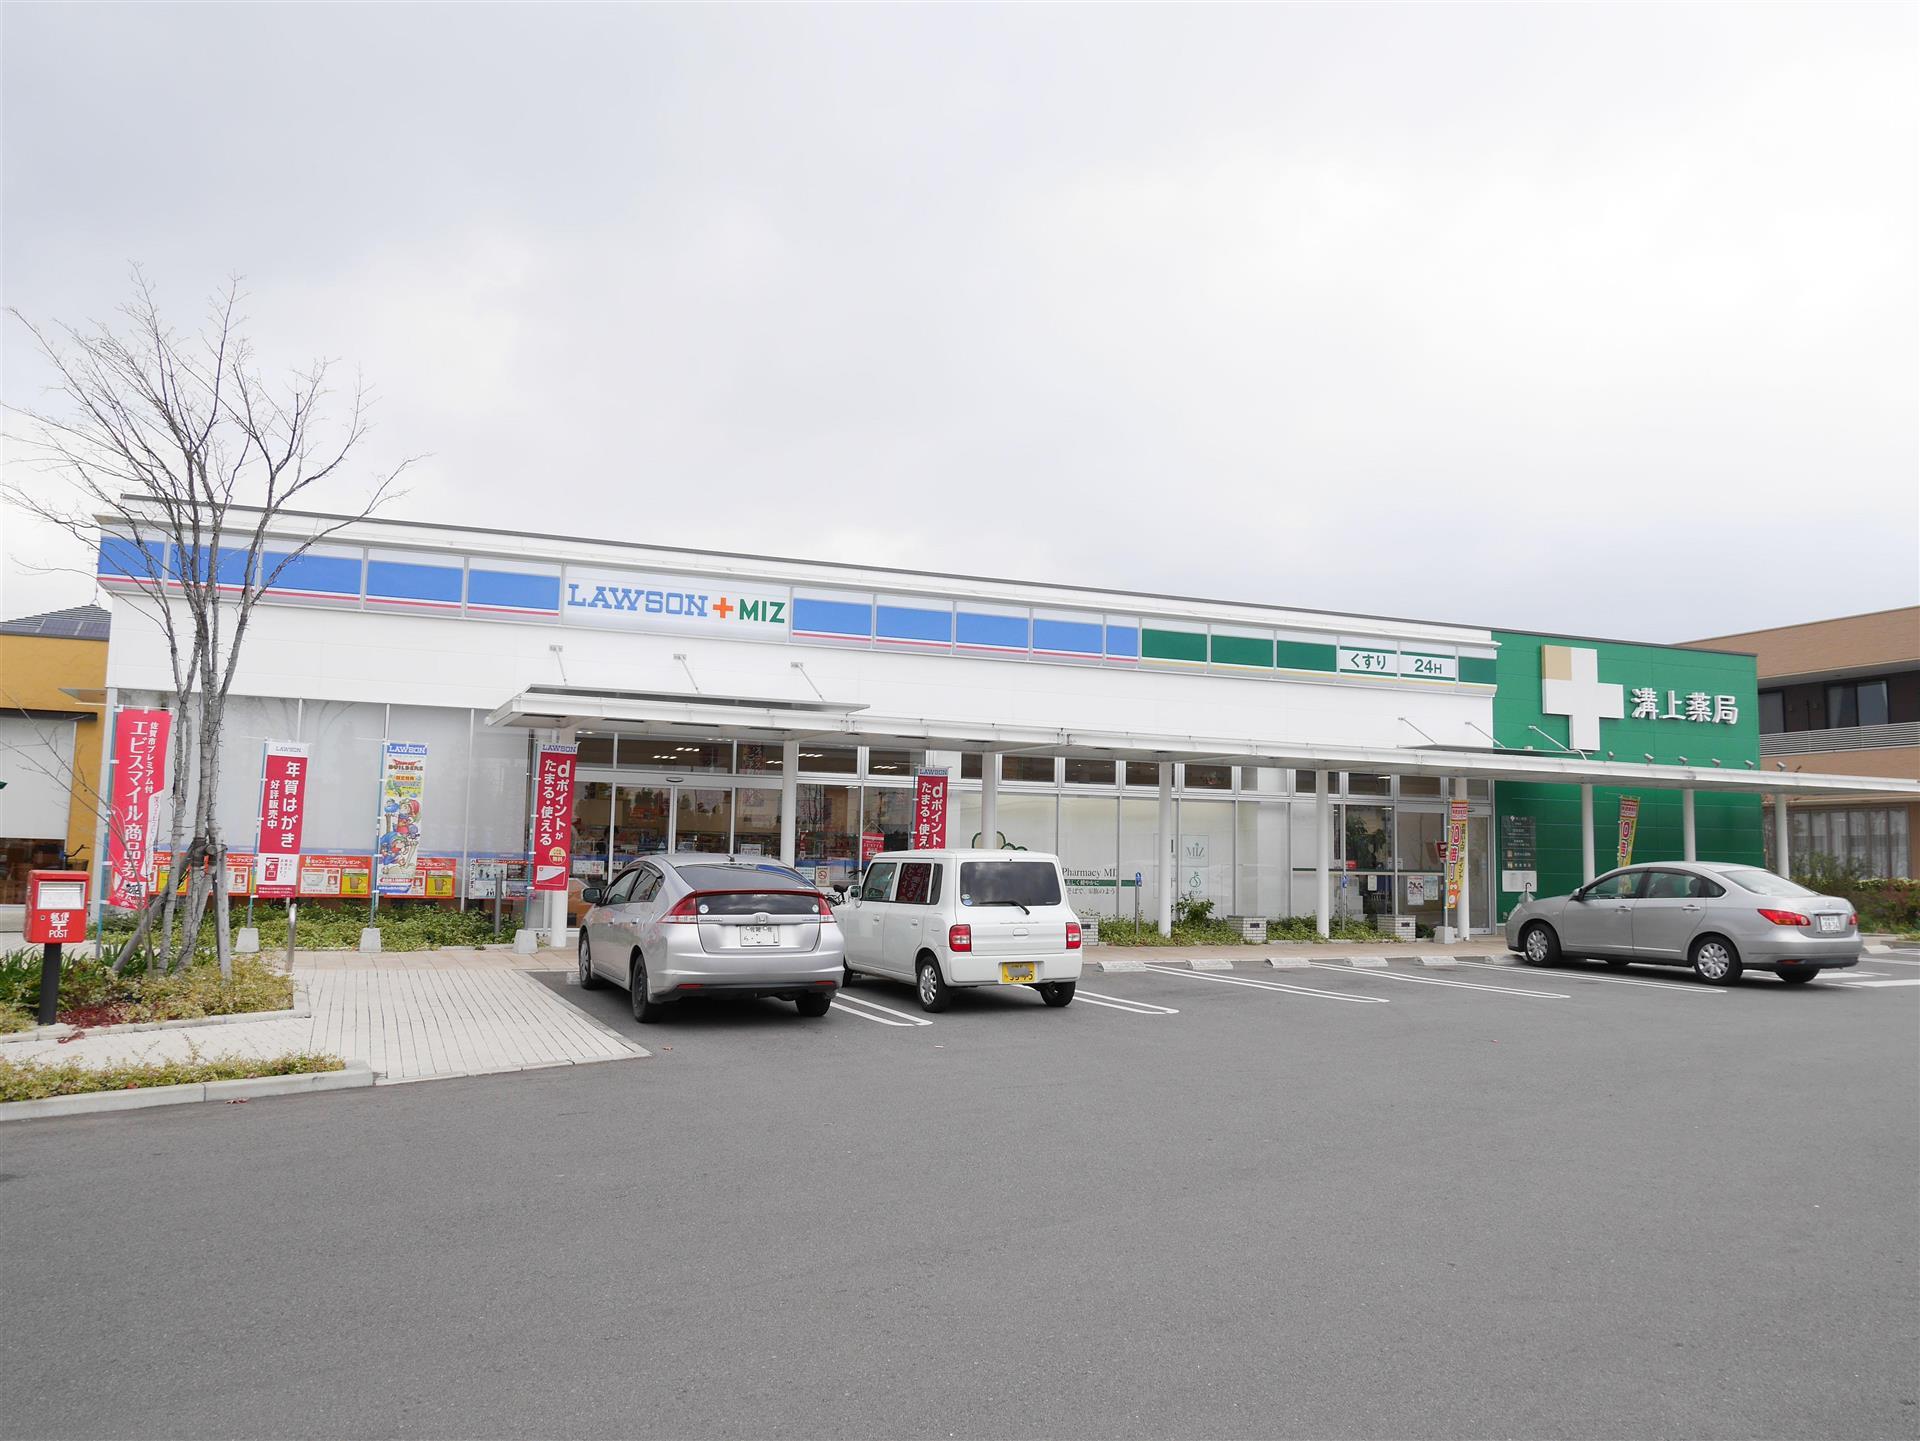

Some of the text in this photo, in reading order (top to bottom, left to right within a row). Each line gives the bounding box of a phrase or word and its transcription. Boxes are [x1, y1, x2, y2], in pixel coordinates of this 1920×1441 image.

[567, 583, 709, 617] LAWSON
[739, 598, 786, 624] MIZ
[1350, 653, 1386, 670] くすり
[1414, 658, 1442, 674] 24H
[1630, 687, 1739, 725] 溝上薬局
[389, 745, 426, 754] LAWSON
[542, 744, 577, 753] LAWSON
[121, 721, 148, 879] エビスマイル商品券
[267, 779, 280, 829] 好評販売中
[281, 761, 301, 848] 年賀はがき
[554, 759, 571, 840] dポイントが
[918, 781, 932, 849] たまる・使え
[931, 782, 944, 848] dポイント
[1062, 867, 1116, 878] Pharmacy MI
[48, 929, 69, 938] POST
[50, 912, 71, 922] 郵便
